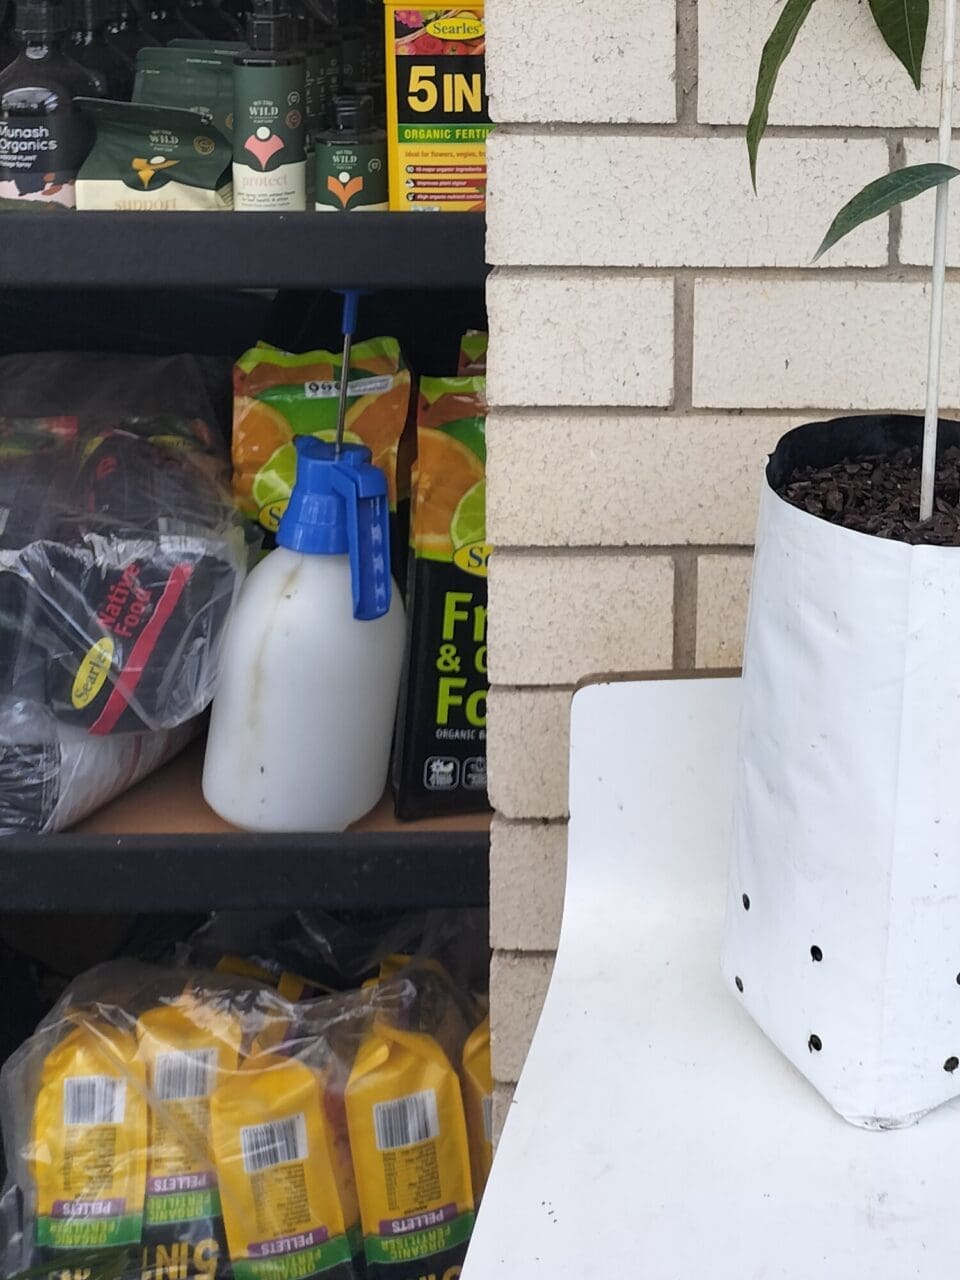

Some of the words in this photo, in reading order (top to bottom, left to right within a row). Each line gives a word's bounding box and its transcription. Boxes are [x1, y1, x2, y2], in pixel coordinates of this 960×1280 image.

[433, 21, 480, 34] Searles
[407, 65, 438, 113] 5
[443, 73, 482, 113] IN
[249, 106, 279, 116] WILD
[0, 125, 49, 139] Munash
[149, 134, 179, 145] WILD
[404, 128, 452, 139] ORGANIC
[0, 138, 58, 153] Organics
[332, 155, 357, 163] WILD
[242, 173, 288, 187] protect
[97, 562, 140, 626] Native
[114, 586, 152, 638] Food
[436, 643, 460, 672] &
[435, 728, 476, 740] ORGANIC
[154, 1175, 207, 1193] PELLETS
[63, 1201, 112, 1216] PELLETS
[391, 1211, 444, 1233] PELLETS
[261, 1233, 314, 1254] PELLETS
[380, 1225, 451, 1250] FERTILISER
[389, 1239, 446, 1259] ORGANIC
[193, 1237, 219, 1280] 5
